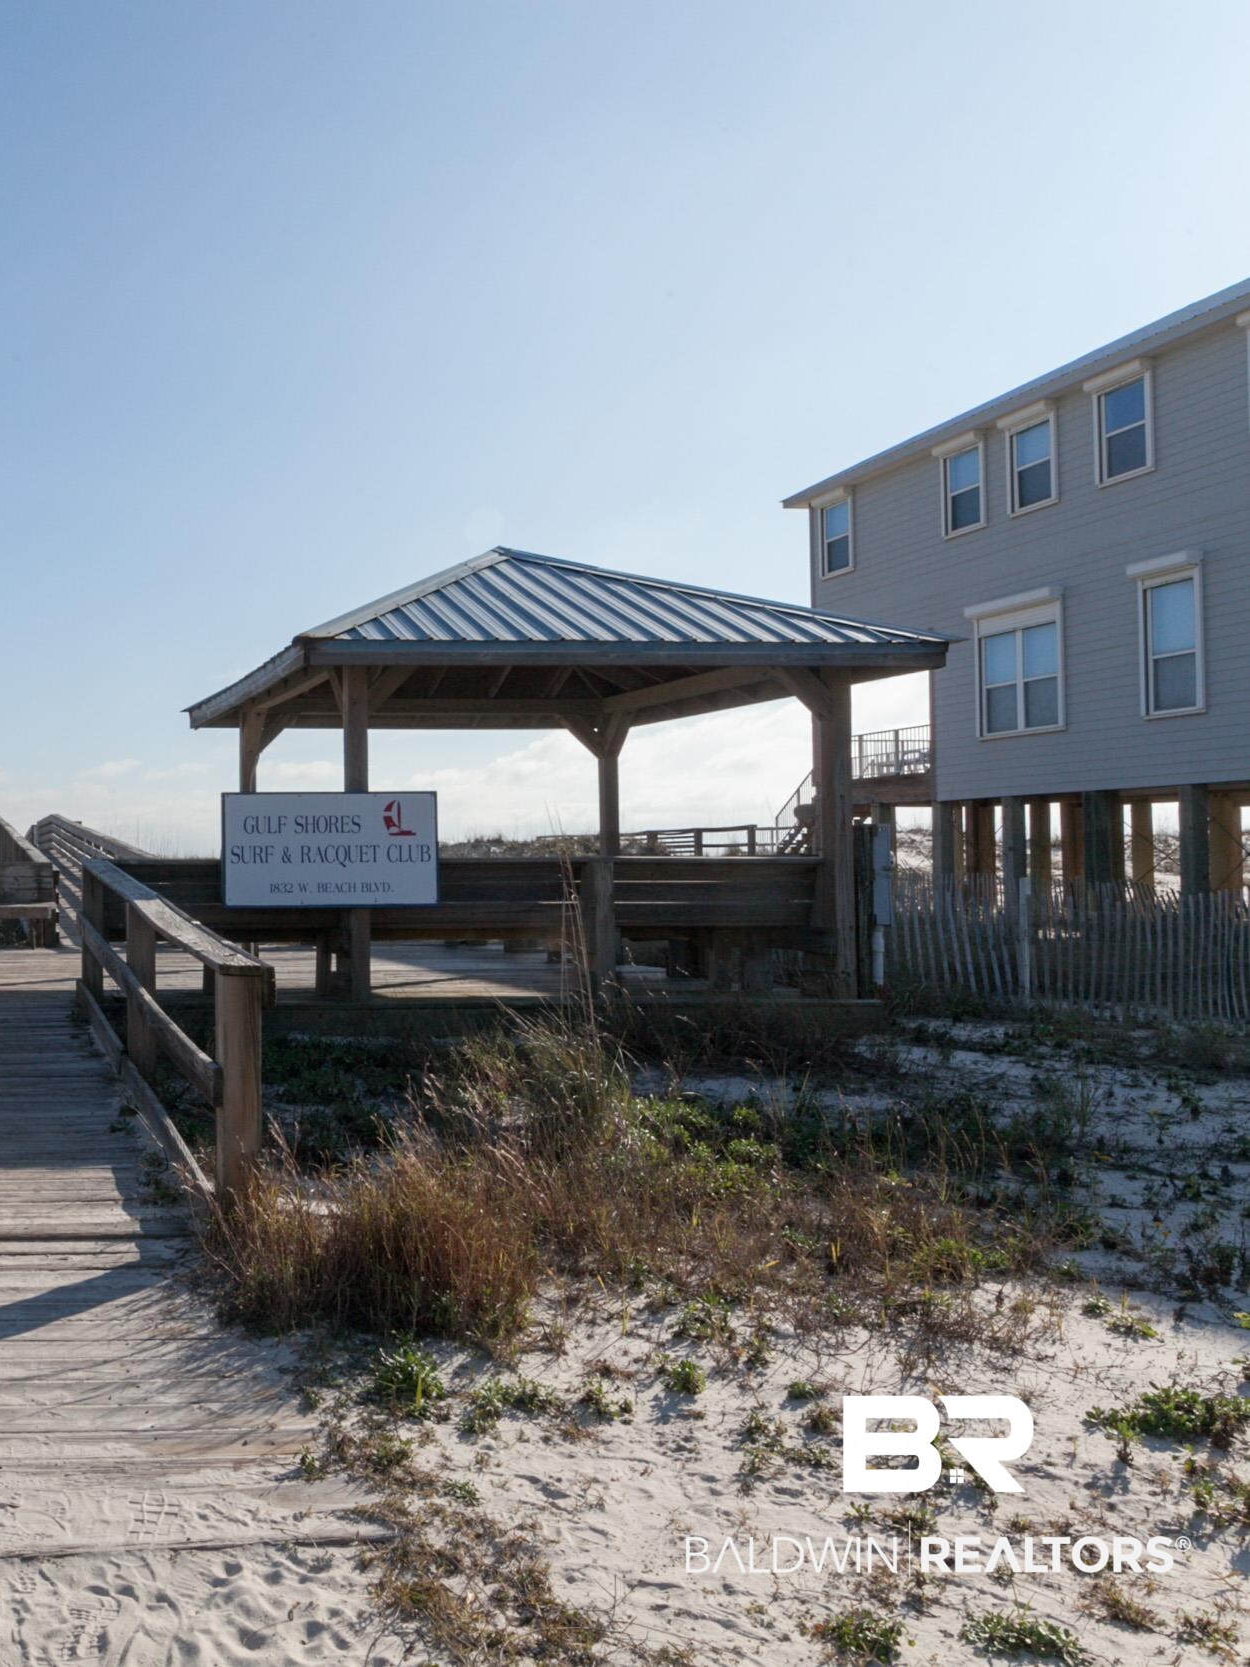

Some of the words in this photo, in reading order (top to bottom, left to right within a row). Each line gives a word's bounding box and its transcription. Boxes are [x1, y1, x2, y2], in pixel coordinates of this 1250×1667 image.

[243, 816, 288, 835] GULF
[294, 815, 361, 834] SHORES
[230, 845, 275, 864] SURF
[282, 846, 292, 864] &
[301, 845, 380, 868] RACQUET
[387, 844, 431, 863] CLUB
[269, 883, 293, 894] 1832
[299, 883, 312, 894] W.
[317, 882, 356, 893] BEACH
[361, 882, 395, 893] BLVD.
